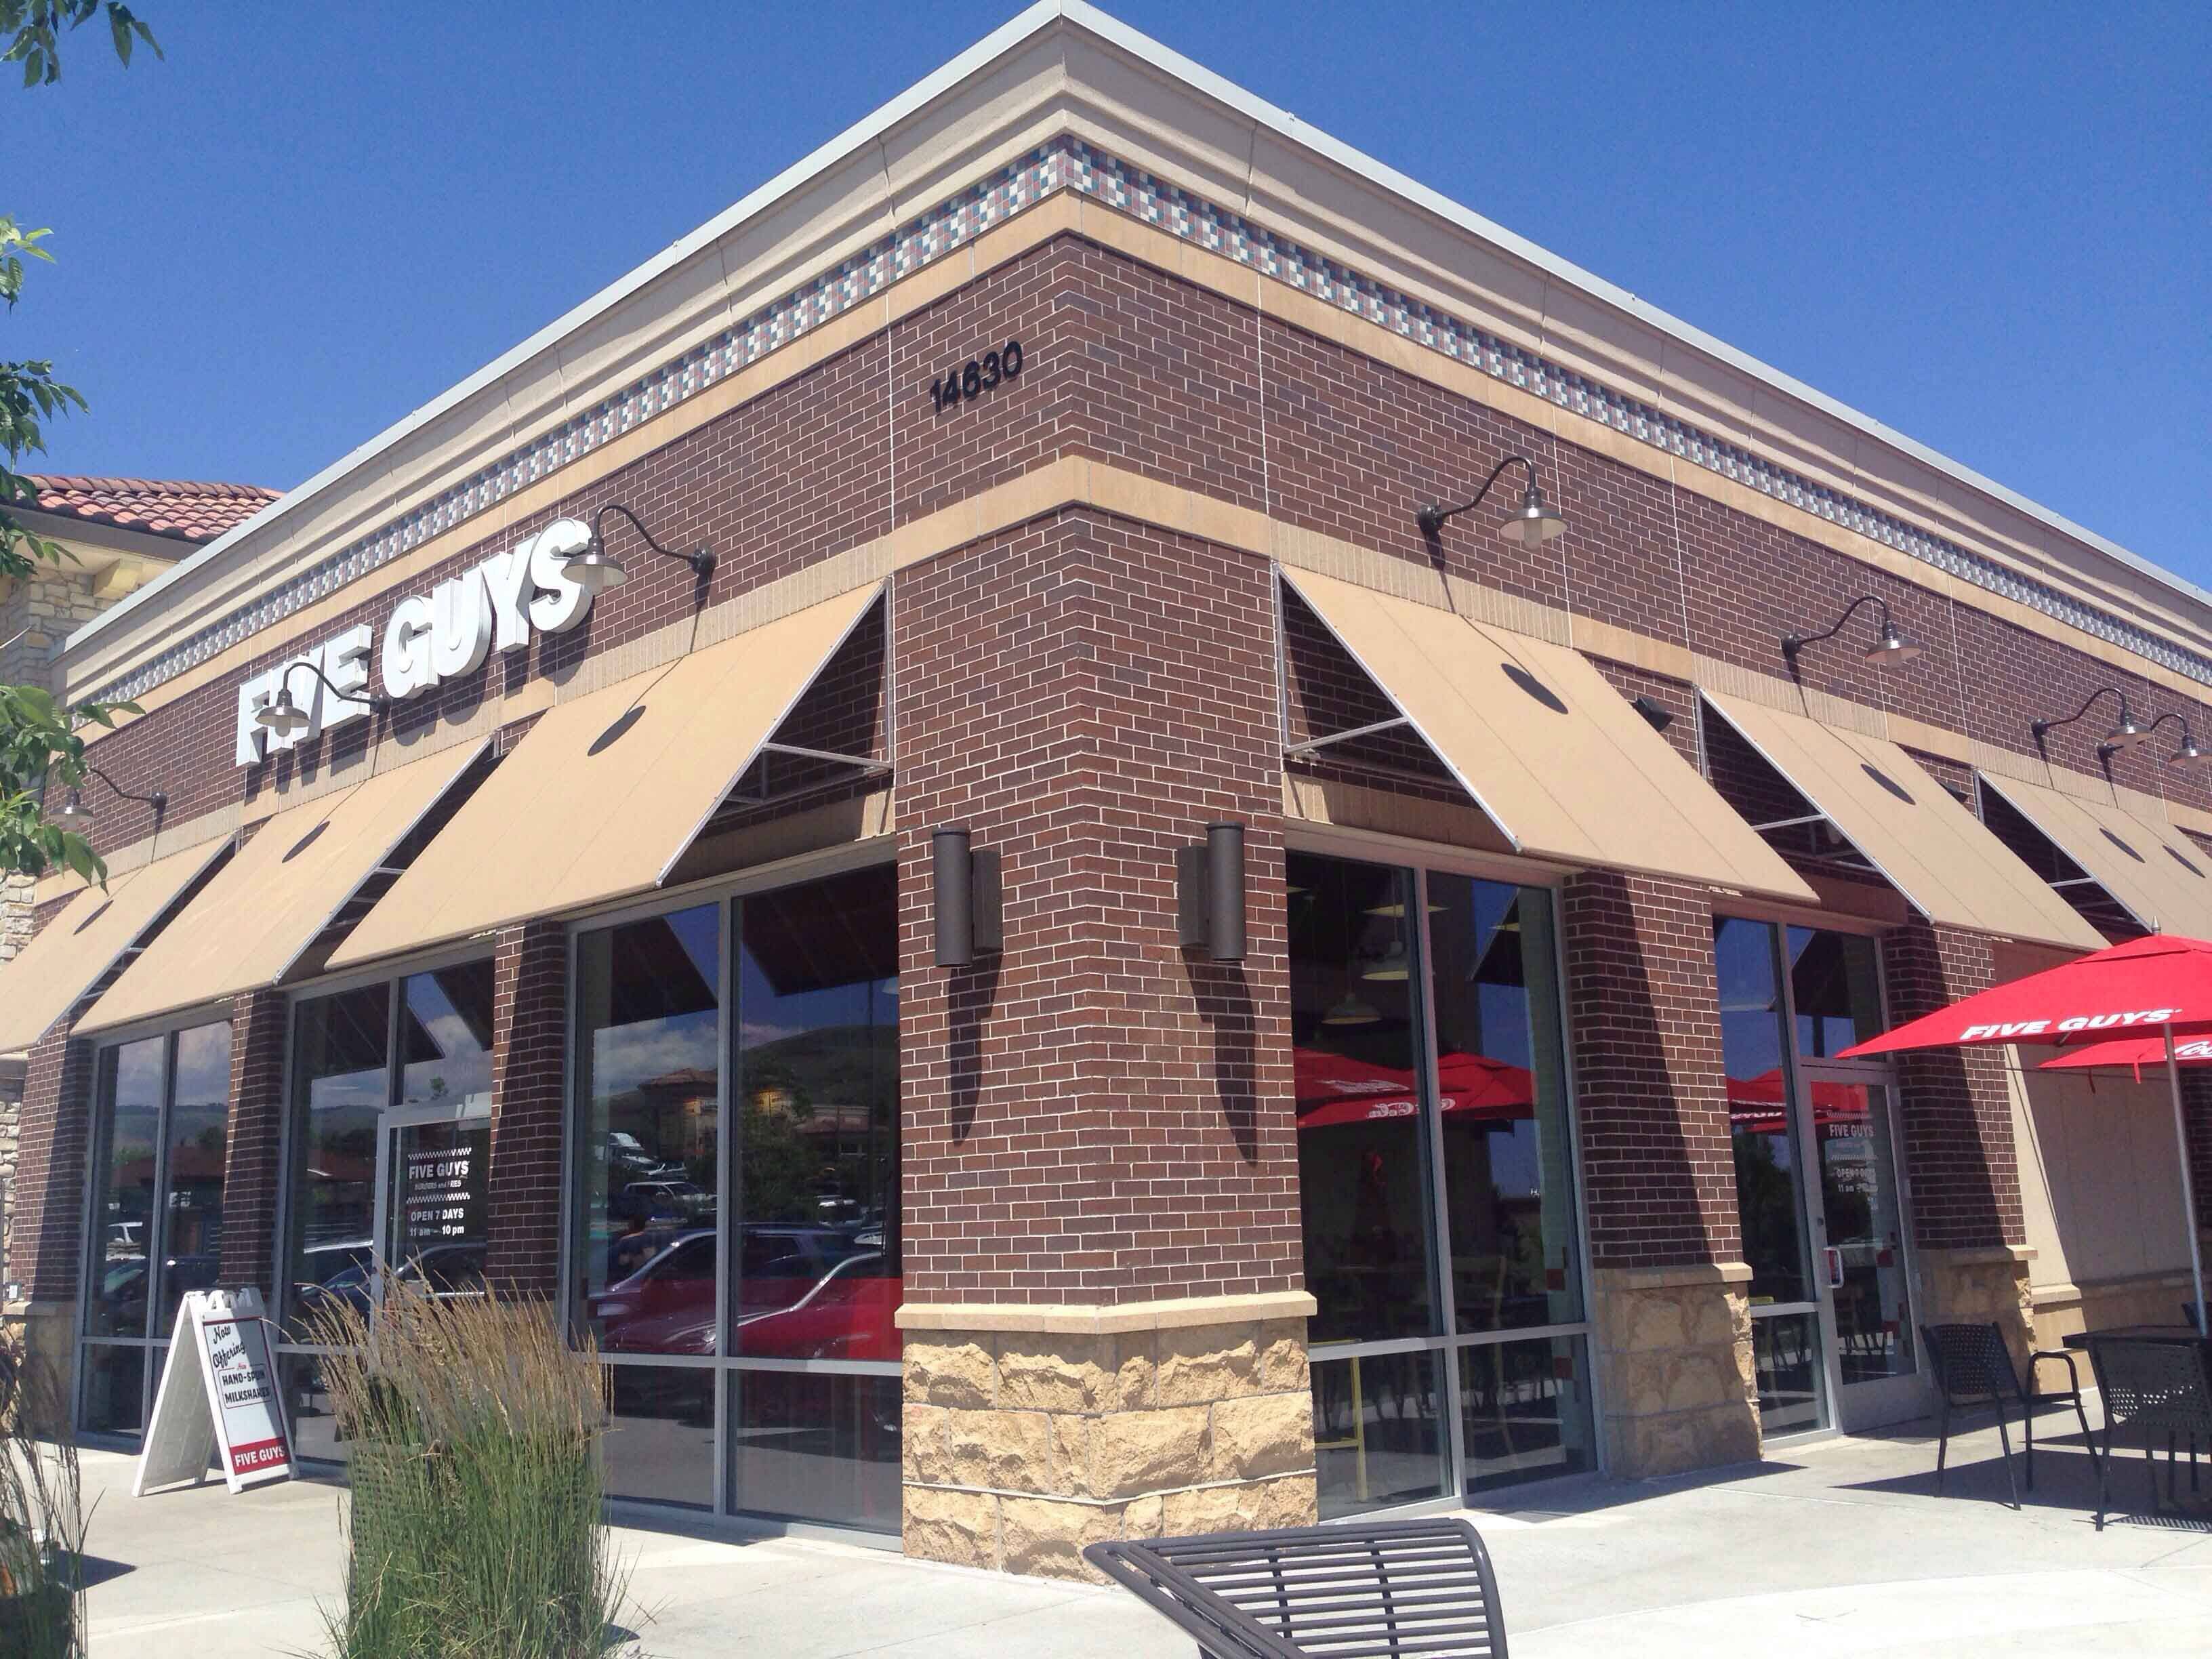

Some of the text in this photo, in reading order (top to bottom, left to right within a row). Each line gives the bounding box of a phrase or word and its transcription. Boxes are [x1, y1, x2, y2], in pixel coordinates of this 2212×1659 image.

[930, 341, 1023, 413] 14630
[236, 517, 594, 767] FIVE GUYS
[1960, 1008, 2175, 1040] FIVE GUYS
[1830, 1124, 1875, 1137] FIVE GUYS
[409, 1160, 469, 1179] FIVE GUYS
[411, 1208, 464, 1221] OPEN 7 DAYS
[410, 1227, 417, 1236] 11
[419, 1228, 430, 1236] am
[442, 1225, 451, 1235] 10
[452, 1225, 464, 1236] pm
[213, 1326, 231, 1344] Now
[213, 1342, 245, 1368] Offering
[224, 1387, 270, 1404] MILKSHAKES
[234, 1446, 285, 1467] FIVE GUYS
